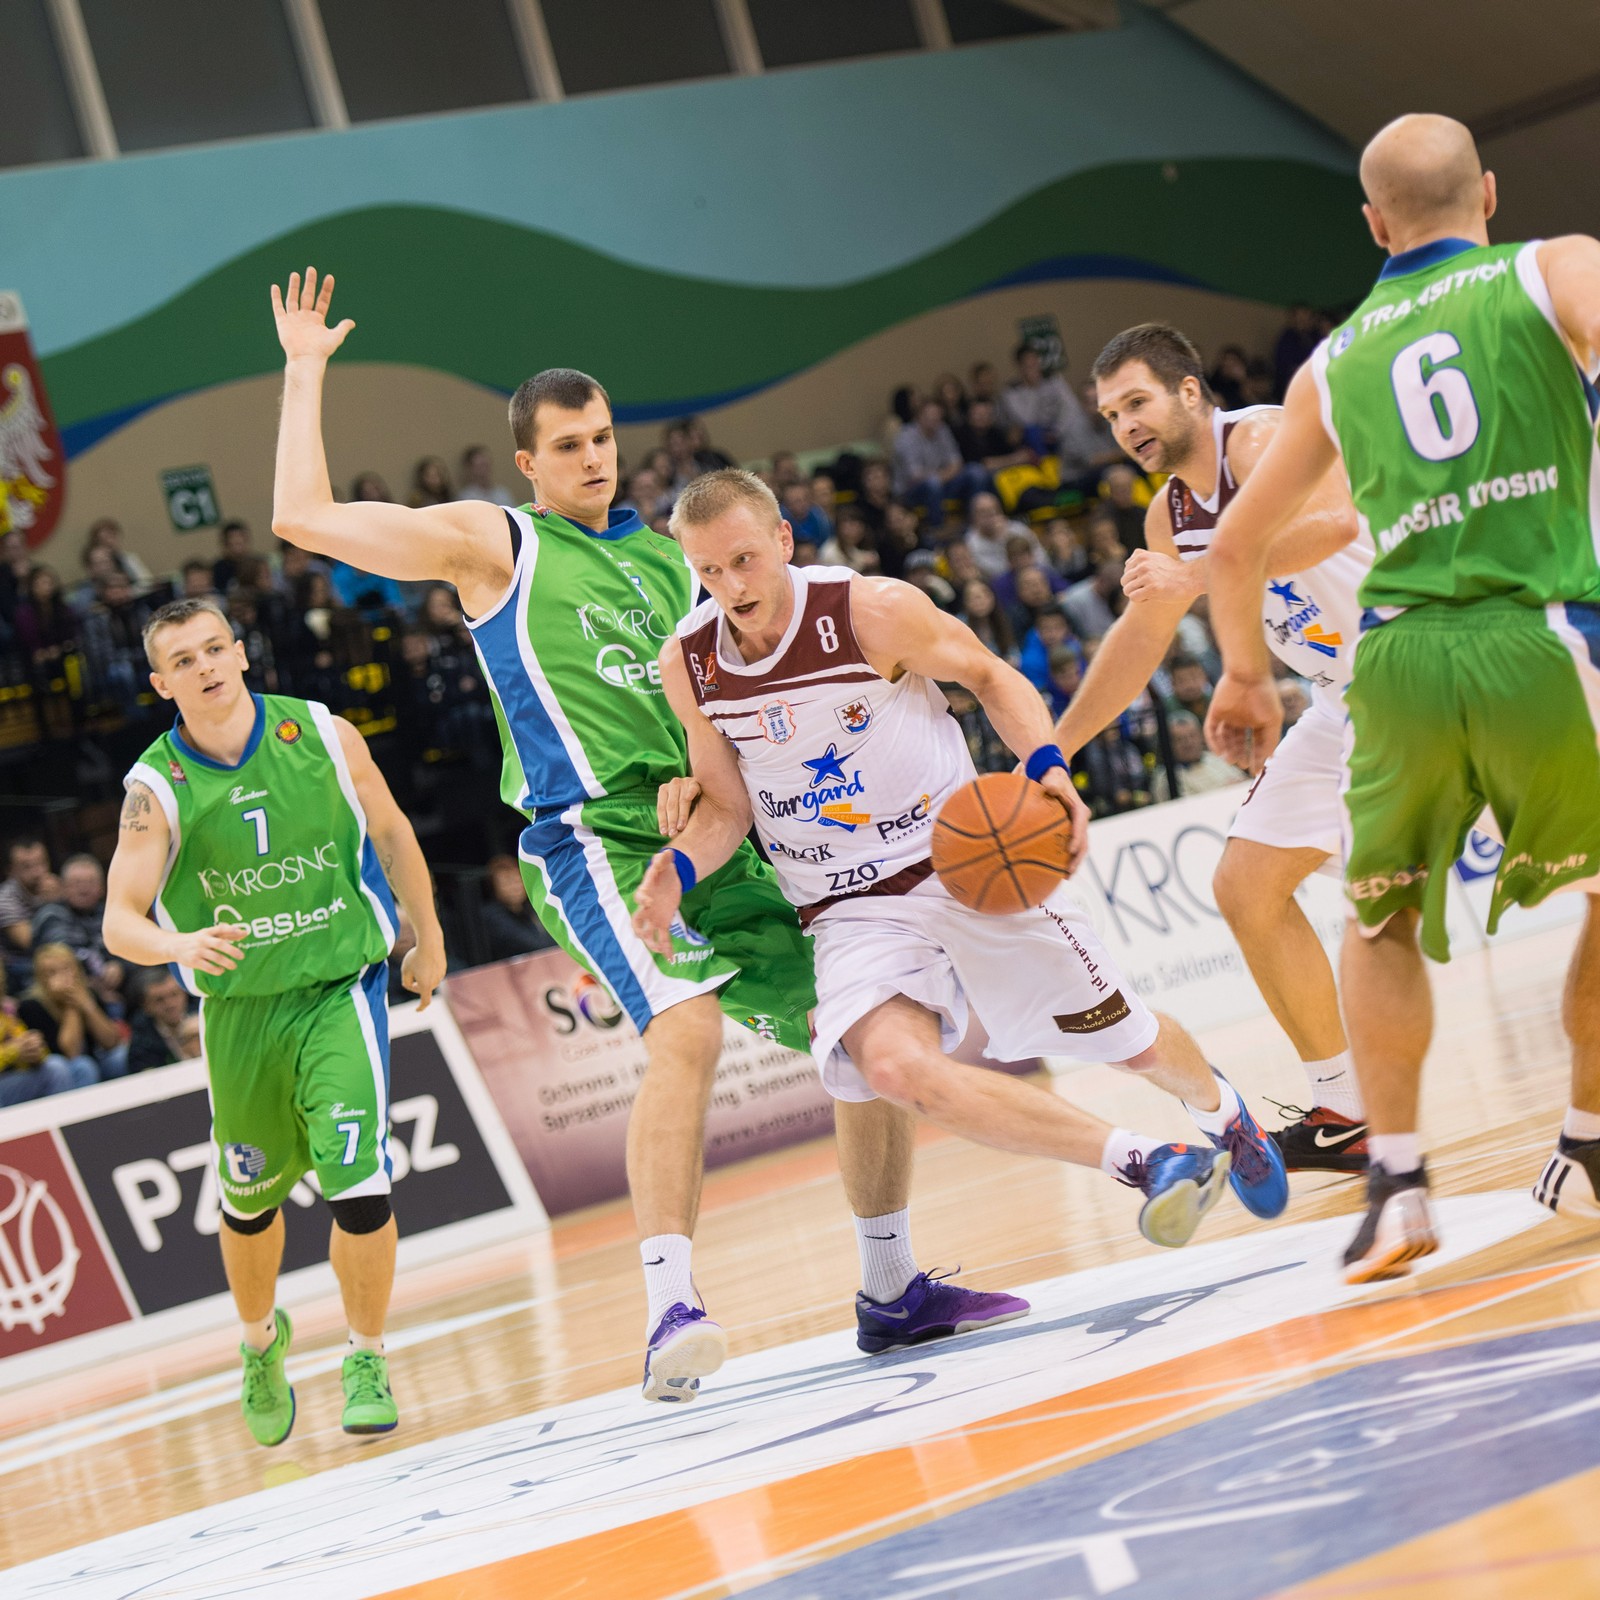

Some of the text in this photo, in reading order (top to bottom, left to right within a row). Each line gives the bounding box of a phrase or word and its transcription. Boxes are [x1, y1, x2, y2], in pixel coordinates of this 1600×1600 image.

[1391, 330, 1480, 462] 6
[171, 488, 217, 528] C1
[815, 616, 840, 653] 8
[758, 770, 865, 823] Stargard
[884, 818, 932, 845] STARGARD
[825, 863, 879, 891] ZZO
[336, 1120, 361, 1166] 7
